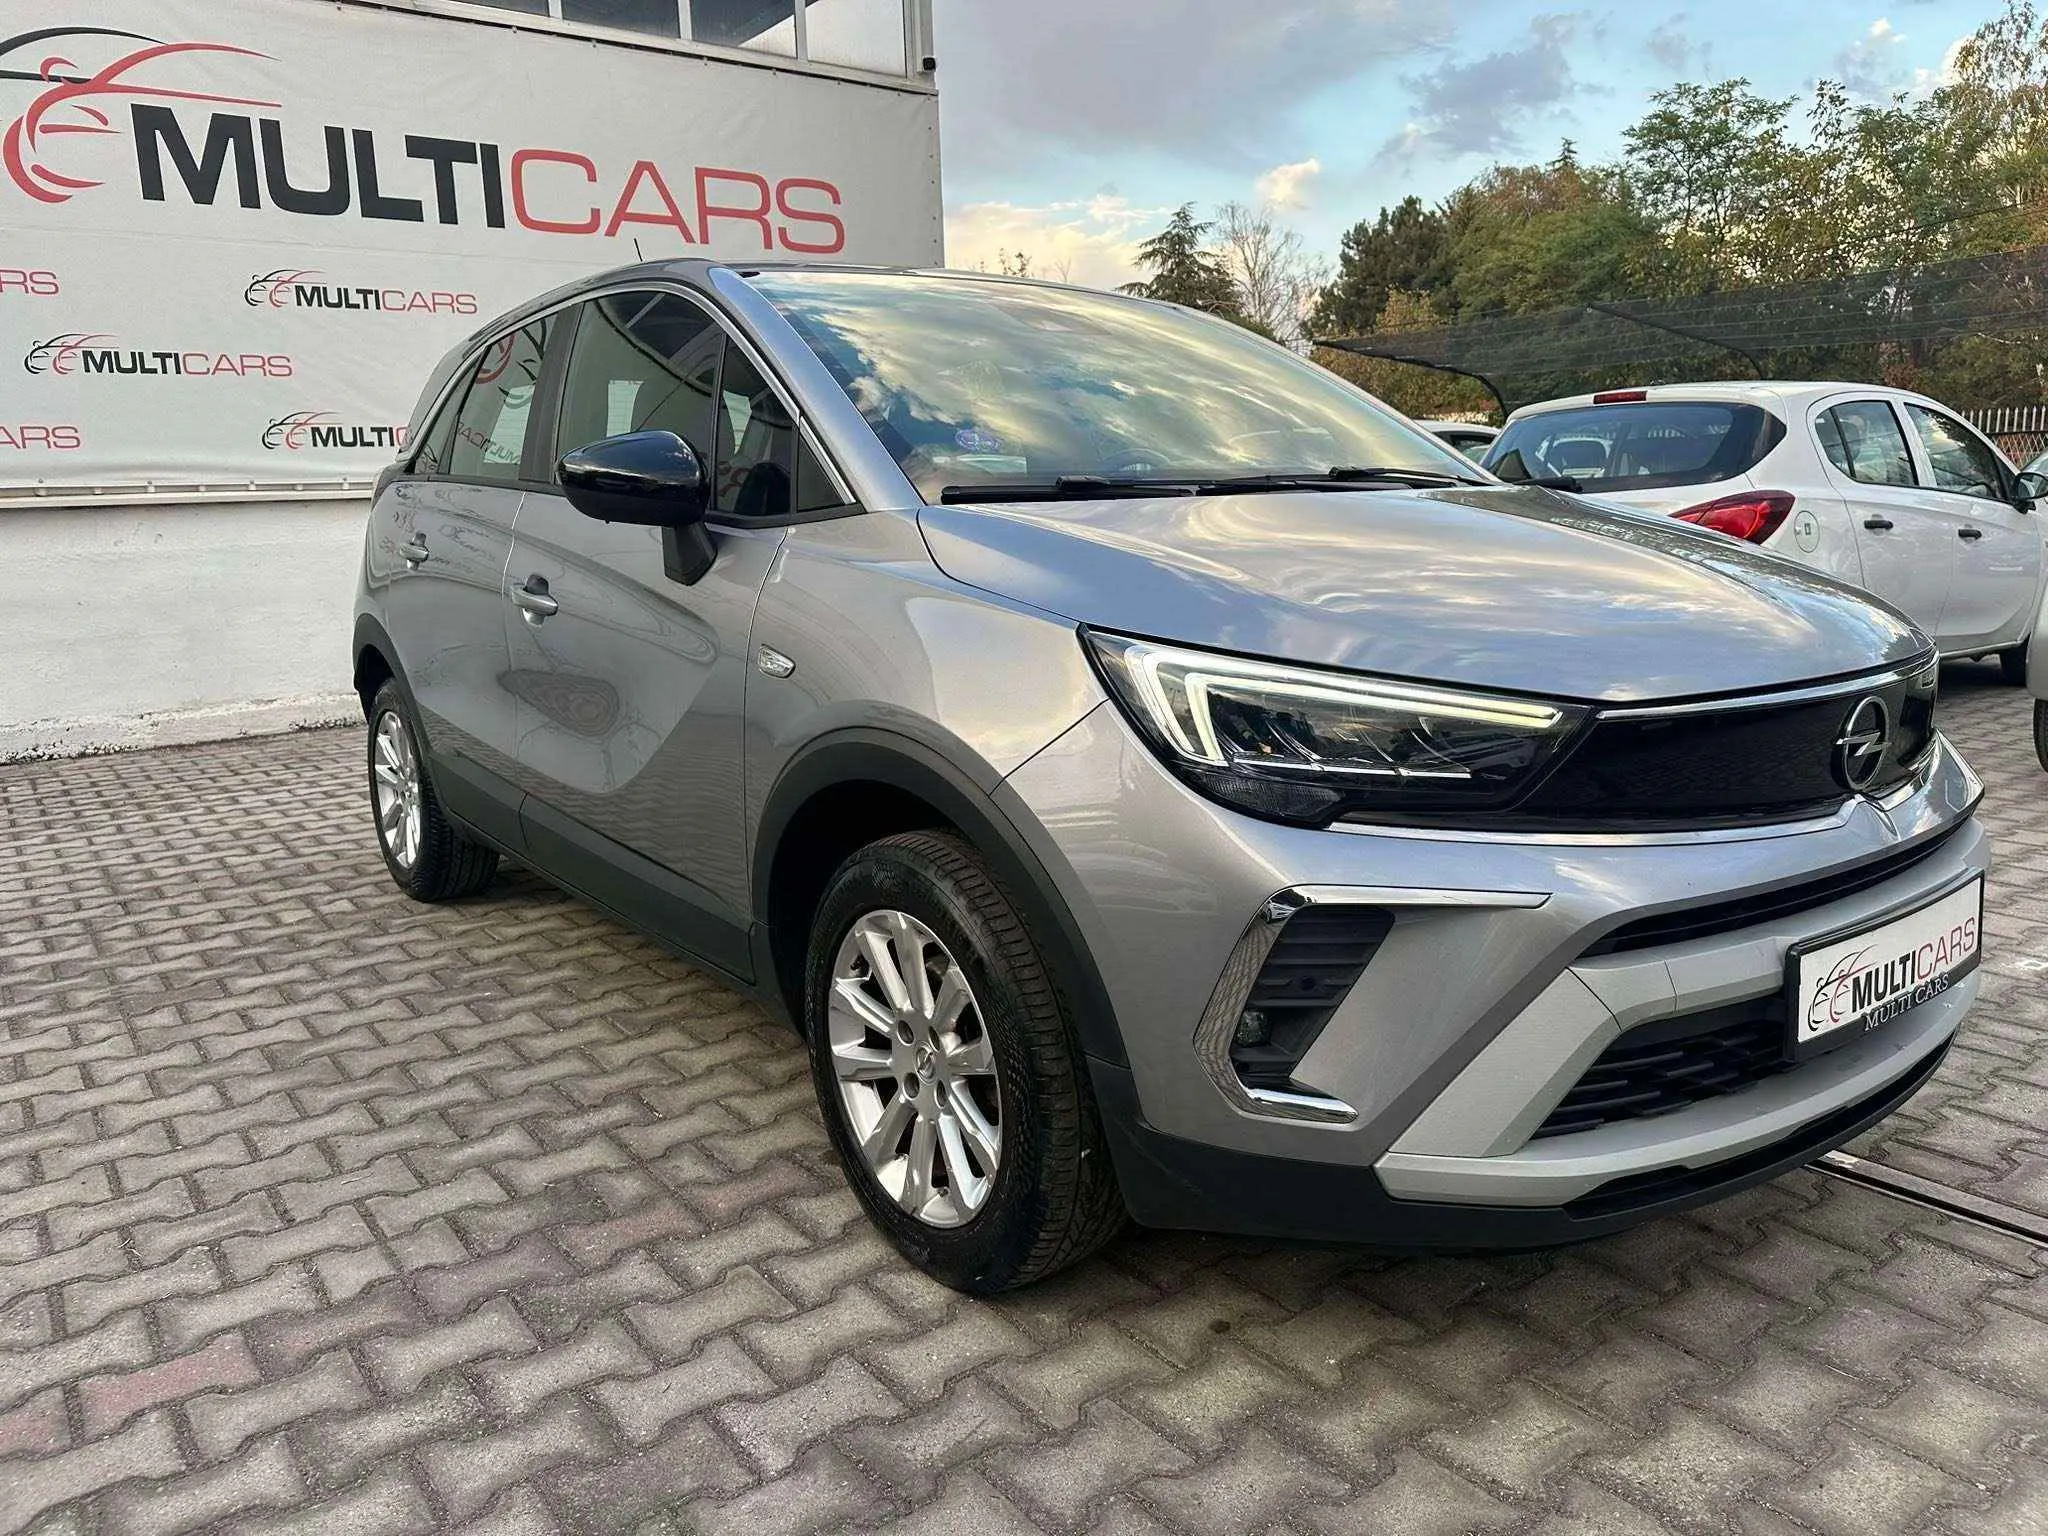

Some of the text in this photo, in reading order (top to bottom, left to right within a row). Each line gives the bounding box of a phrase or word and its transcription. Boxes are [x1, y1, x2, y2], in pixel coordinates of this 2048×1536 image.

[131, 103, 846, 255] MULTICARS
[295, 285, 478, 315] MULTICARS
[82, 349, 293, 377] MULTICARS
[1851, 916, 1975, 1014] MULTICARS
[1864, 975, 1949, 1032] MULTI CARS
